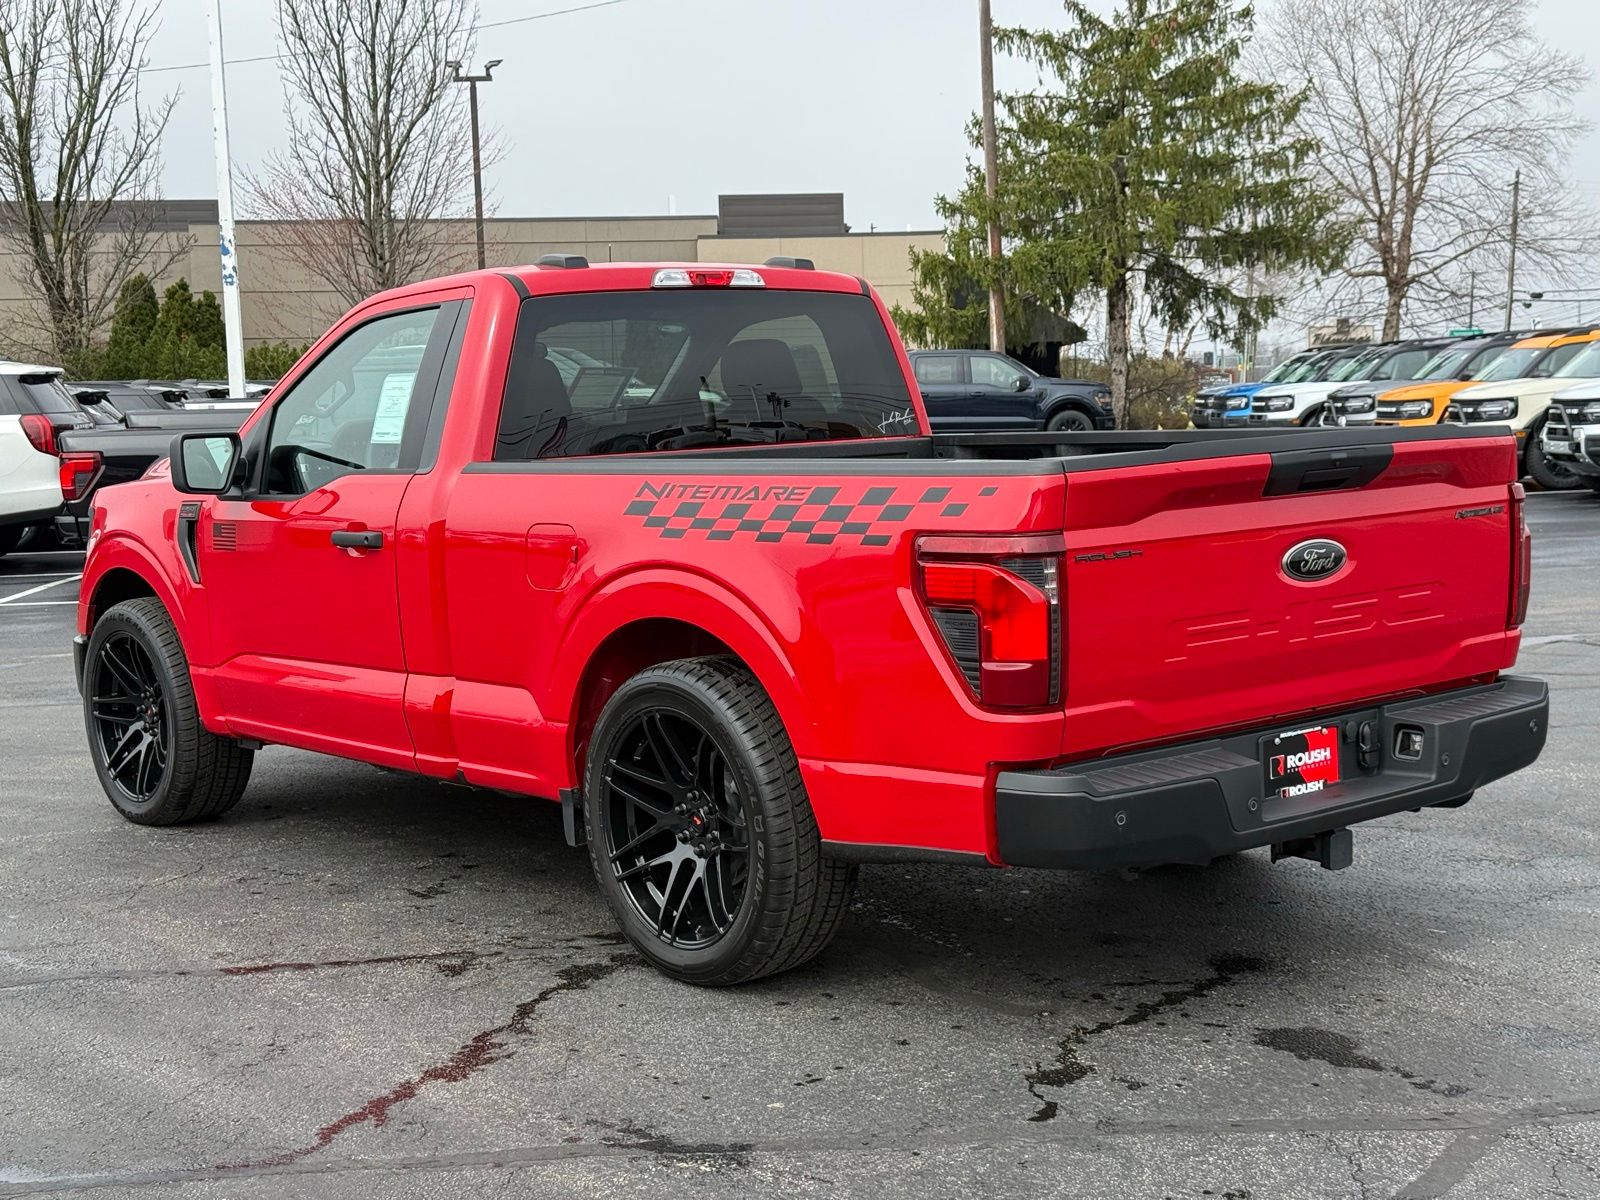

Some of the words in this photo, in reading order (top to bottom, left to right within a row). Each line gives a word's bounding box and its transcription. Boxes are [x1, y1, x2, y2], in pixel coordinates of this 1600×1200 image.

[635, 480, 812, 501] NITEMARE
[1300, 548, 1335, 572] Ford
[1286, 747, 1331, 769] ROUSH
[1288, 779, 1324, 797] ROUSH
